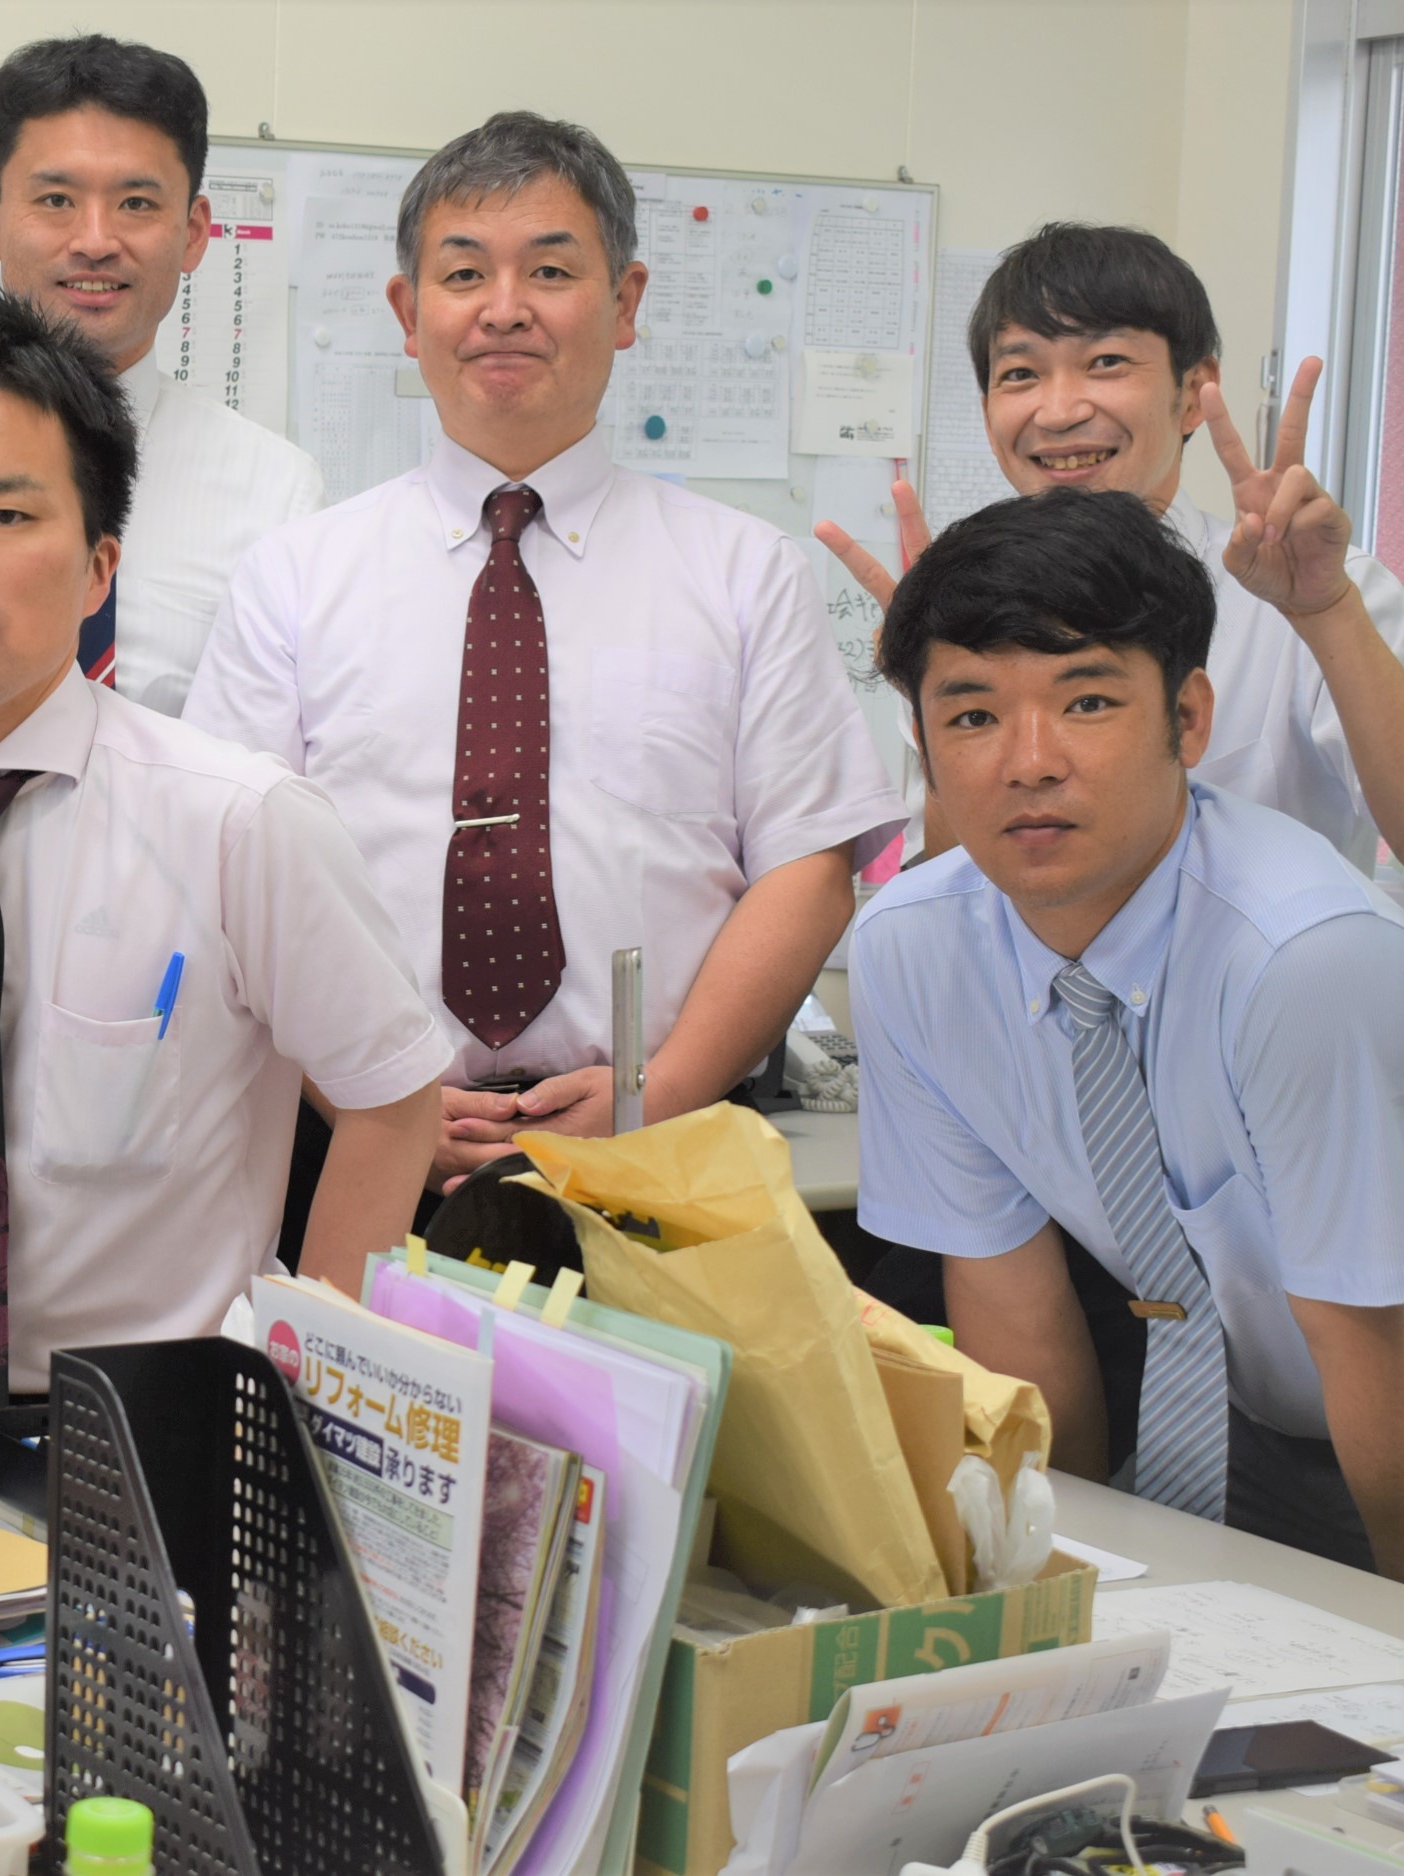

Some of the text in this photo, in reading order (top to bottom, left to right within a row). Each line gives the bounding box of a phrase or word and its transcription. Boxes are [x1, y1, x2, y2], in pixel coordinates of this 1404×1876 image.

[234, 243, 241, 255] 1
[233, 257, 243, 270] 2
[233, 271, 243, 284] 3
[181, 284, 191, 296] 4
[233, 286, 242, 297] 4
[181, 298, 191, 310] 5
[233, 300, 243, 312] 5
[181, 312, 191, 325] 6
[233, 314, 242, 326] 6
[182, 326, 191, 338] 7
[234, 328, 242, 340] 7
[180, 340, 190, 353] 8
[232, 342, 242, 354] 8
[180, 355, 190, 367] 9
[232, 356, 241, 369] 9
[173, 369, 189, 381] 10
[225, 370, 240, 383] 10
[225, 385, 238, 397] 11
[303, 1331, 464, 1415] どこに頼んでいいか分からない
[305, 1355, 463, 1465] リフォーム修理
[384, 1445, 458, 1505] 承ります
